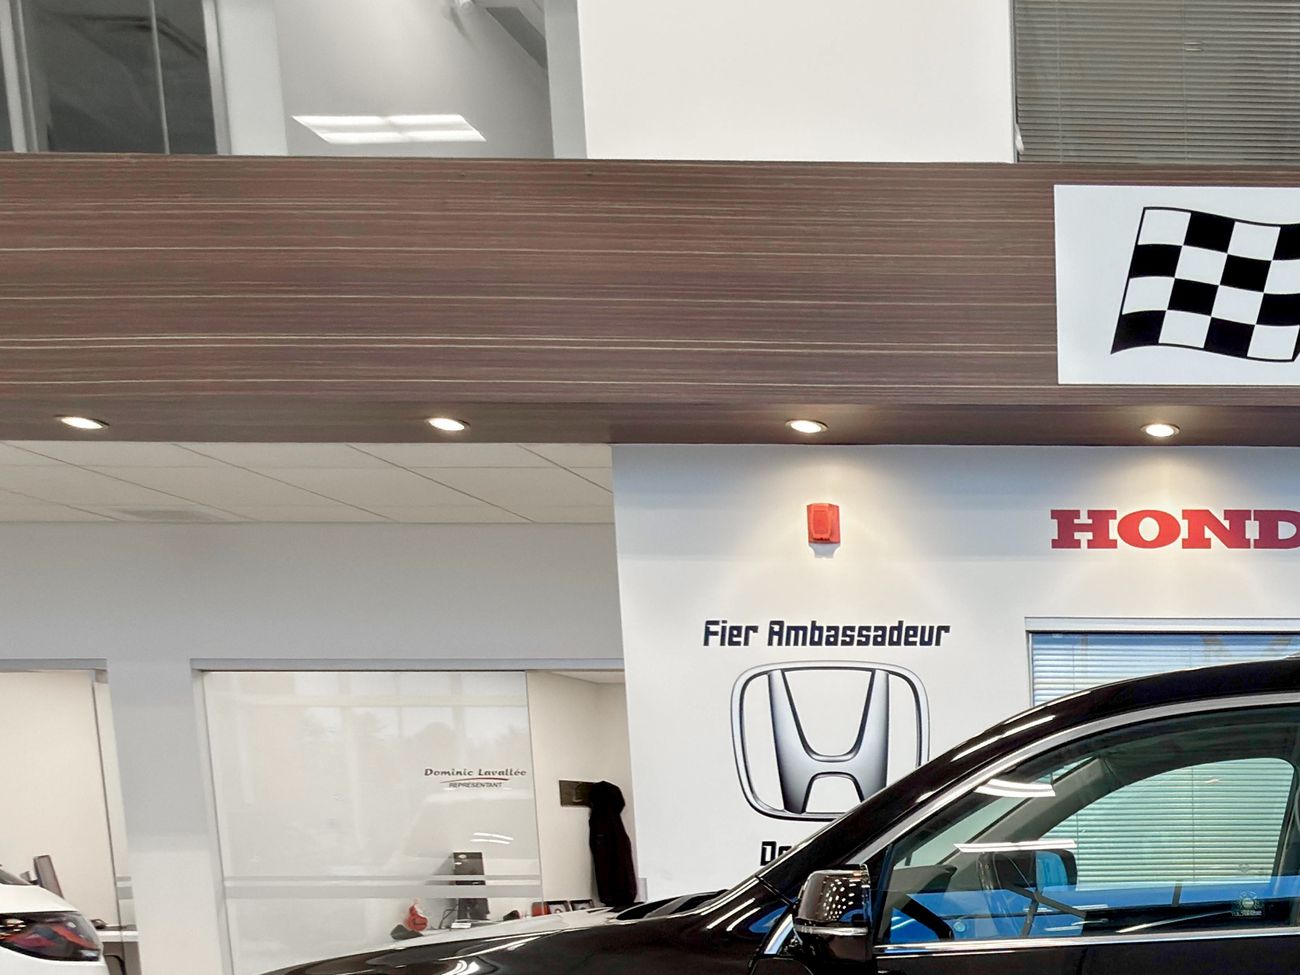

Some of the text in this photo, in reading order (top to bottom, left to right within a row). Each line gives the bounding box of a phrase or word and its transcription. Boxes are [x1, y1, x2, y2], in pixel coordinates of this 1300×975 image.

[702, 619, 951, 647] Fier Ambassadeur
[424, 768, 527, 776] Dominic Lavallée
